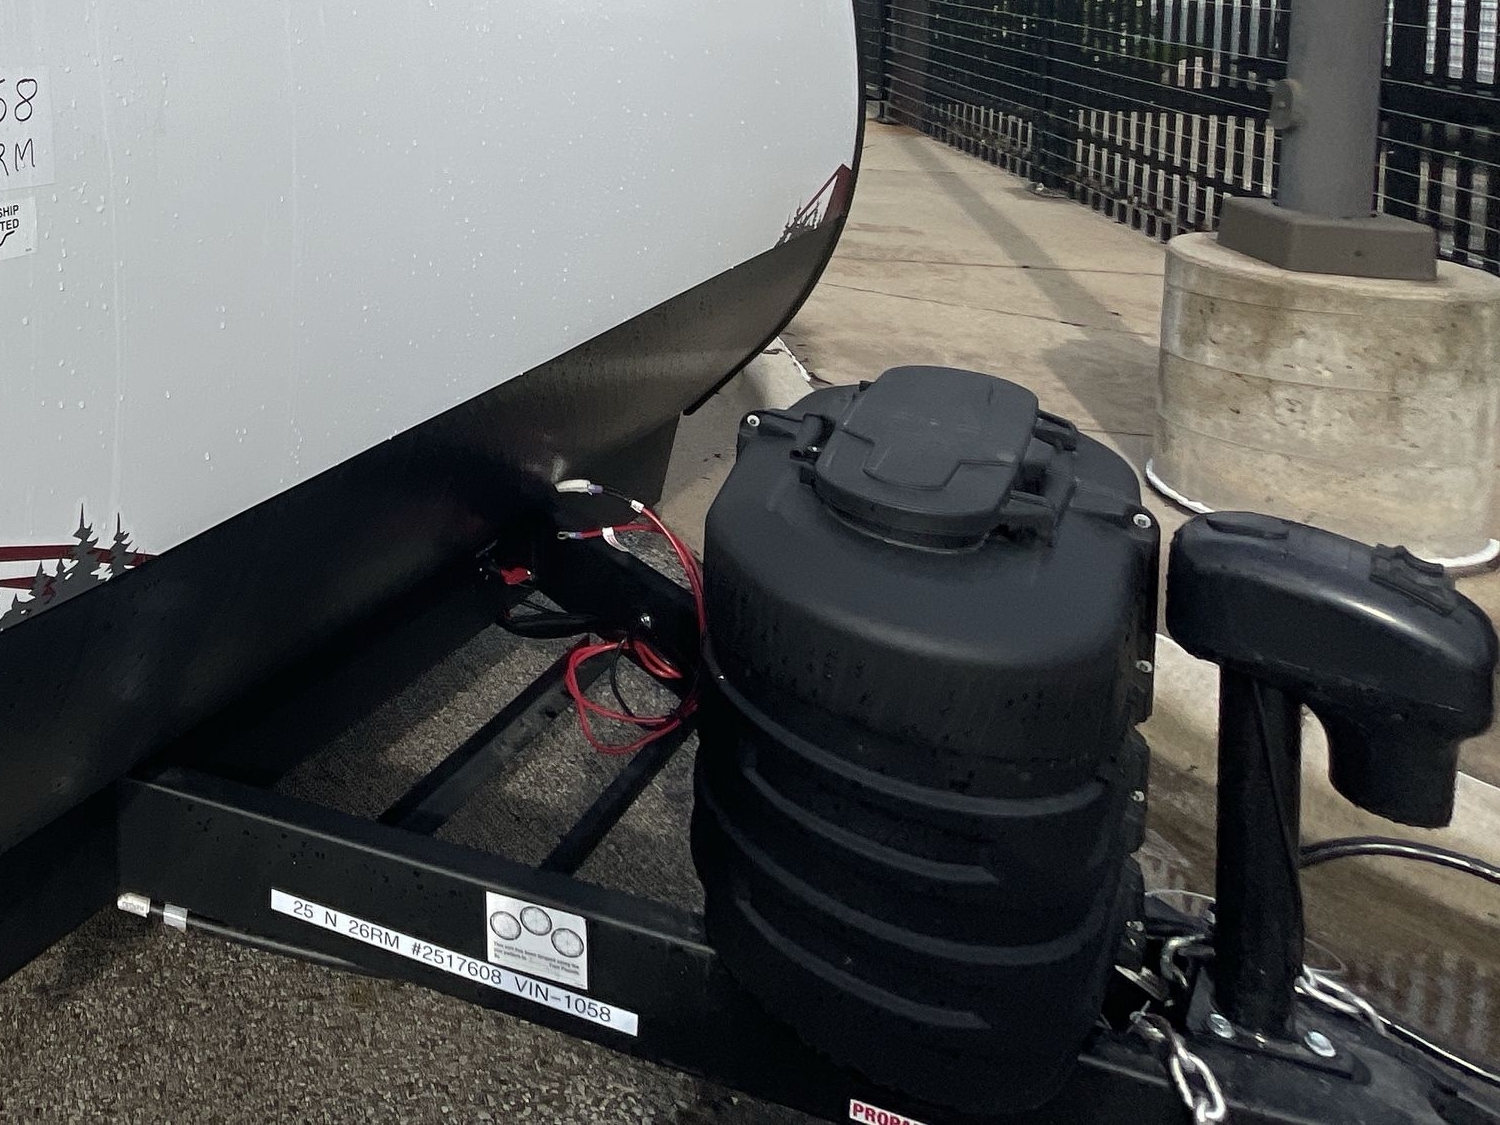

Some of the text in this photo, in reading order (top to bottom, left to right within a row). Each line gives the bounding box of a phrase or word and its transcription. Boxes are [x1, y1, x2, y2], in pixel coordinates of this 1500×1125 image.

[293, 900, 314, 919] 25
[324, 911, 337, 927] N
[348, 919, 400, 950] 26RM
[411, 941, 502, 985] #2517608
[514, 975, 612, 1022] VIN-1058
